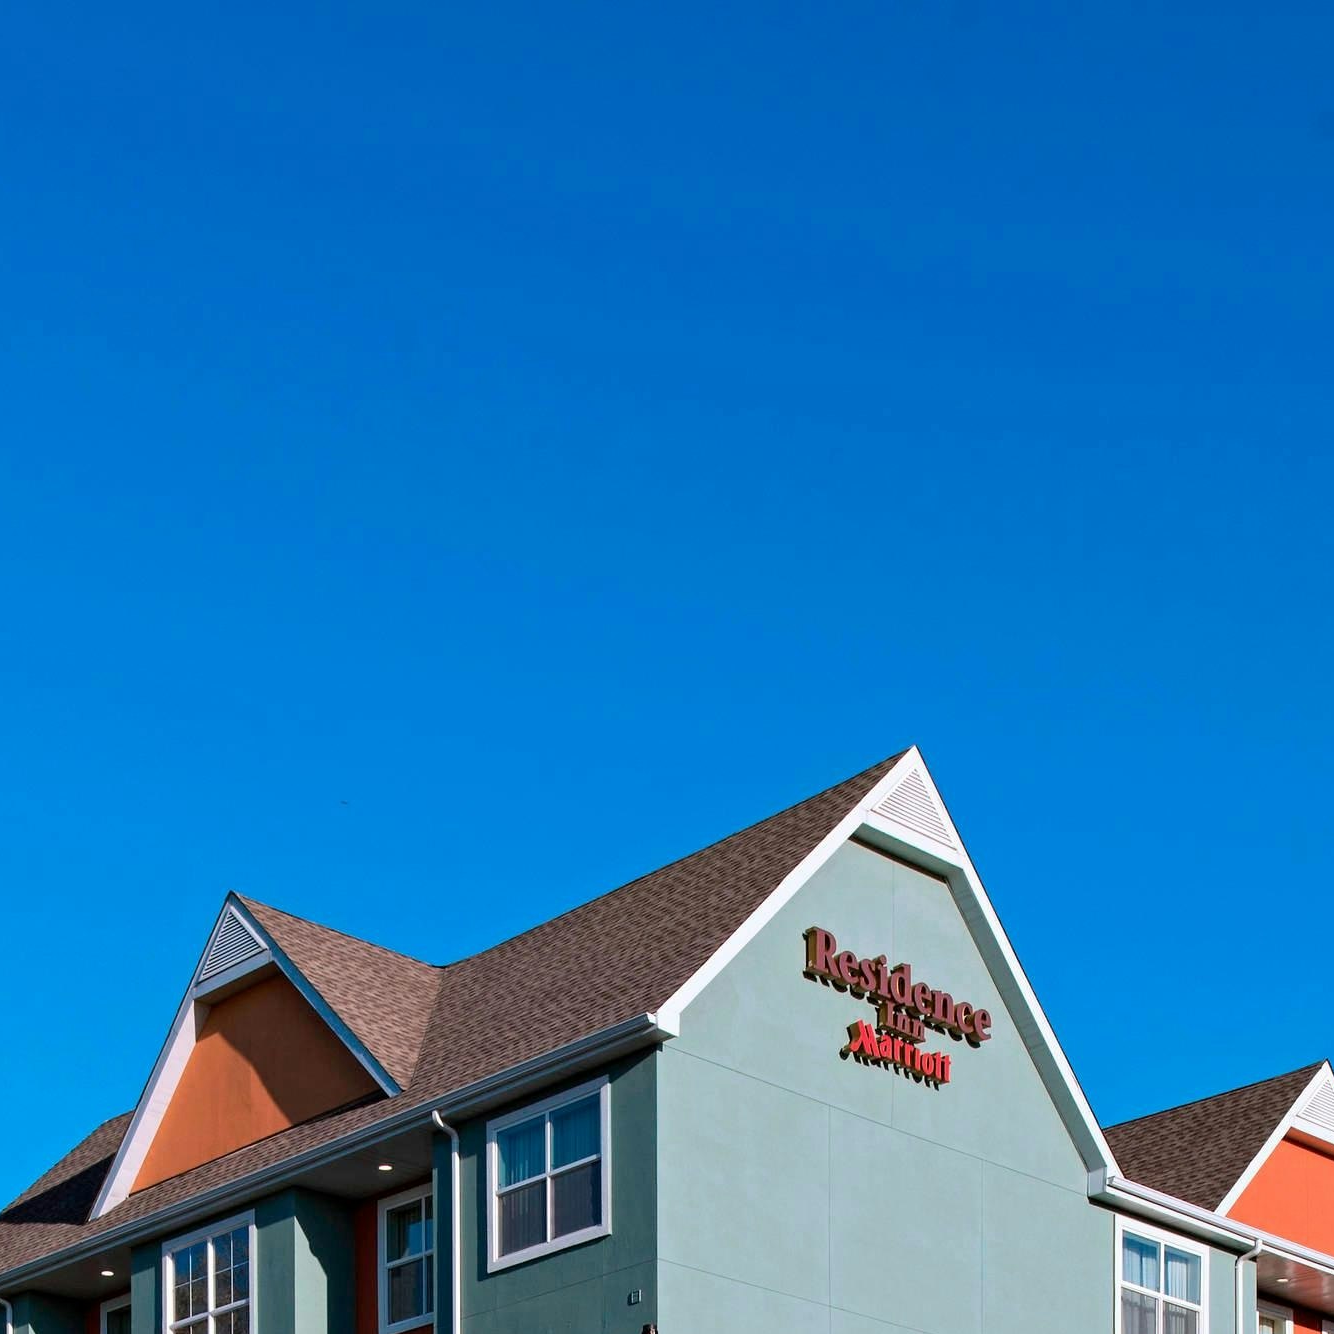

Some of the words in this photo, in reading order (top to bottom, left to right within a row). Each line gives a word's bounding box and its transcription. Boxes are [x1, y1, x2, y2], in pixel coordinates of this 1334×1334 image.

[805, 927, 992, 1041] Residence
[847, 1019, 952, 1083] Marriott
[879, 1001, 926, 1043] Inn
